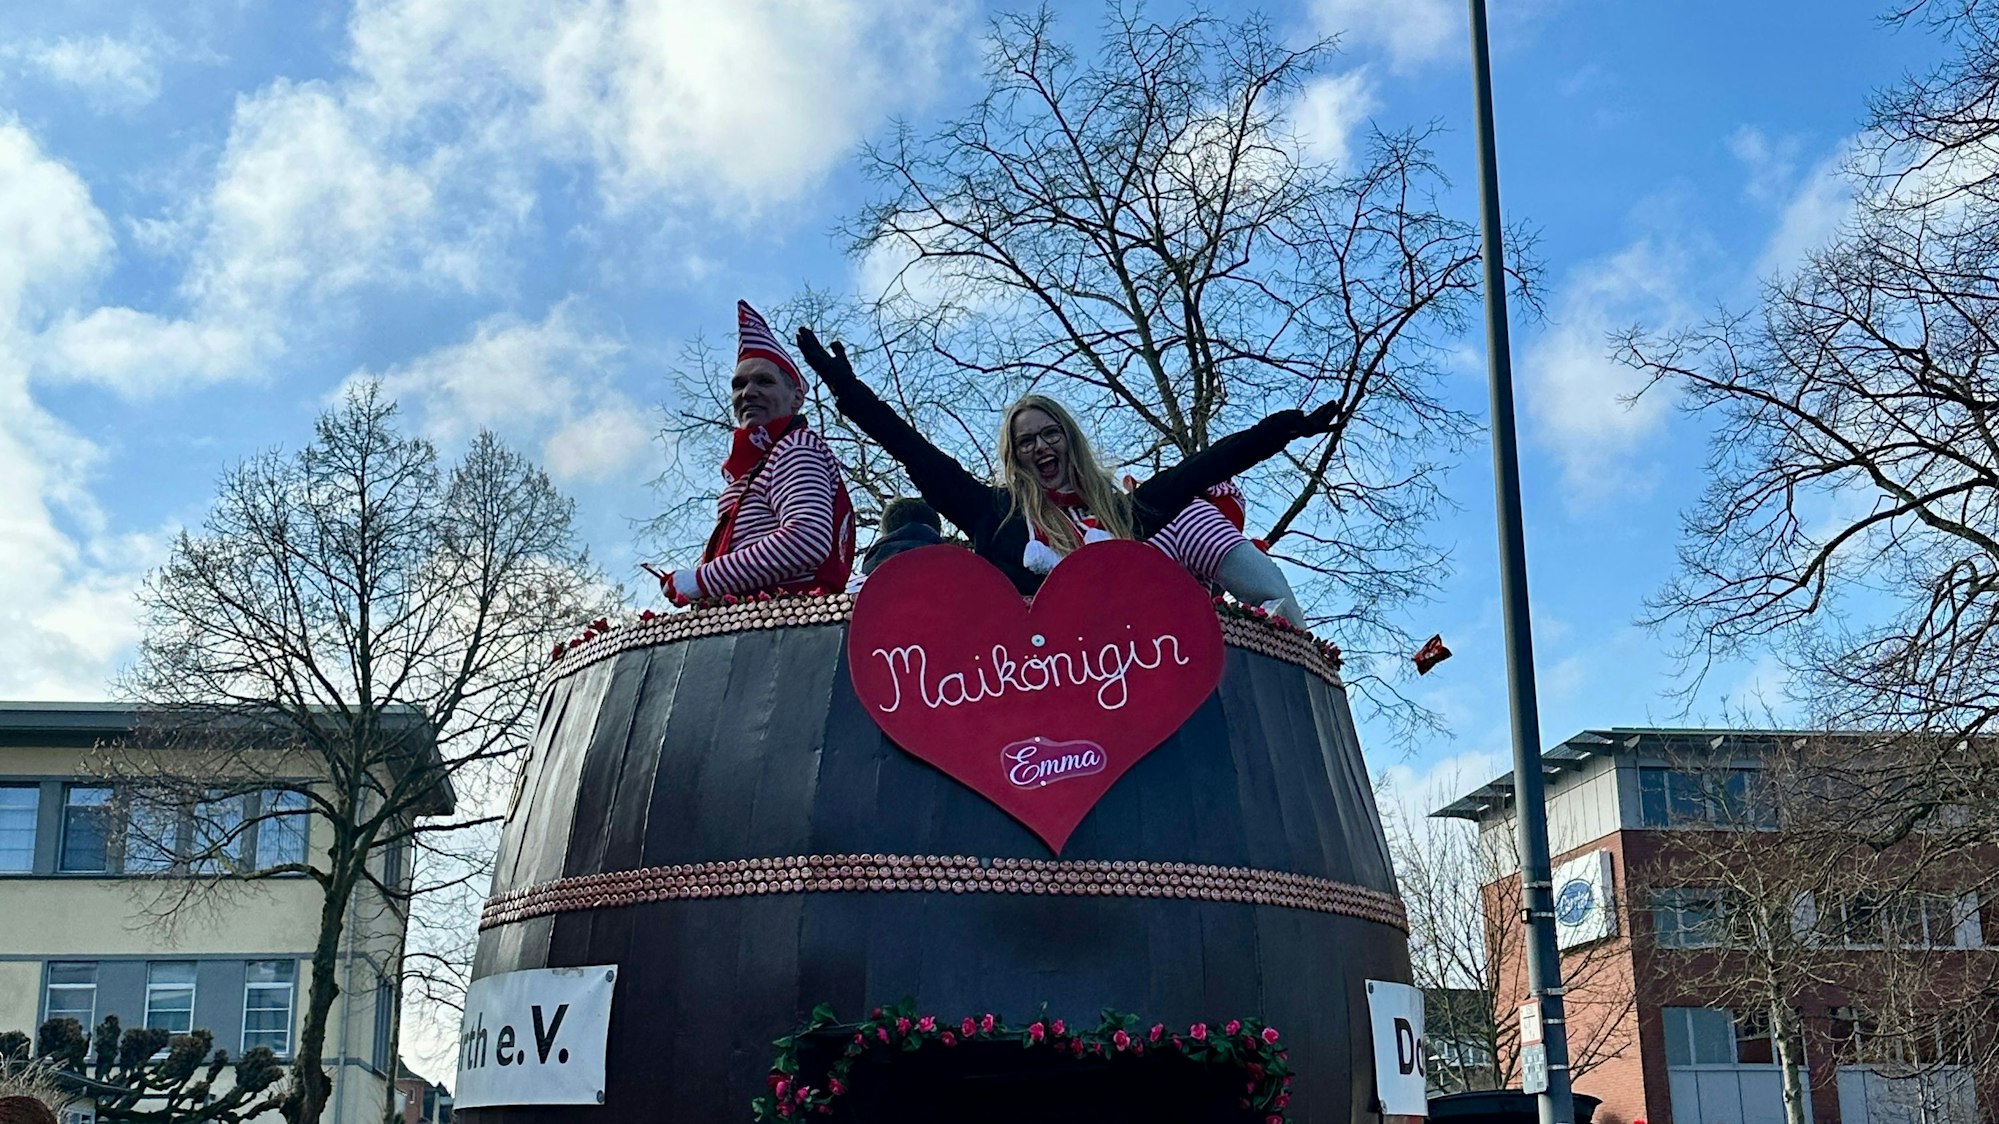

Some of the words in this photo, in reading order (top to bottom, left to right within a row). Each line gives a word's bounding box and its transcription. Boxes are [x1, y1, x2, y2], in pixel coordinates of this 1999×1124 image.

[872, 624, 1189, 712] Maikönigin
[1005, 746, 1100, 785] Emma
[496, 1004, 570, 1066] e.V.
